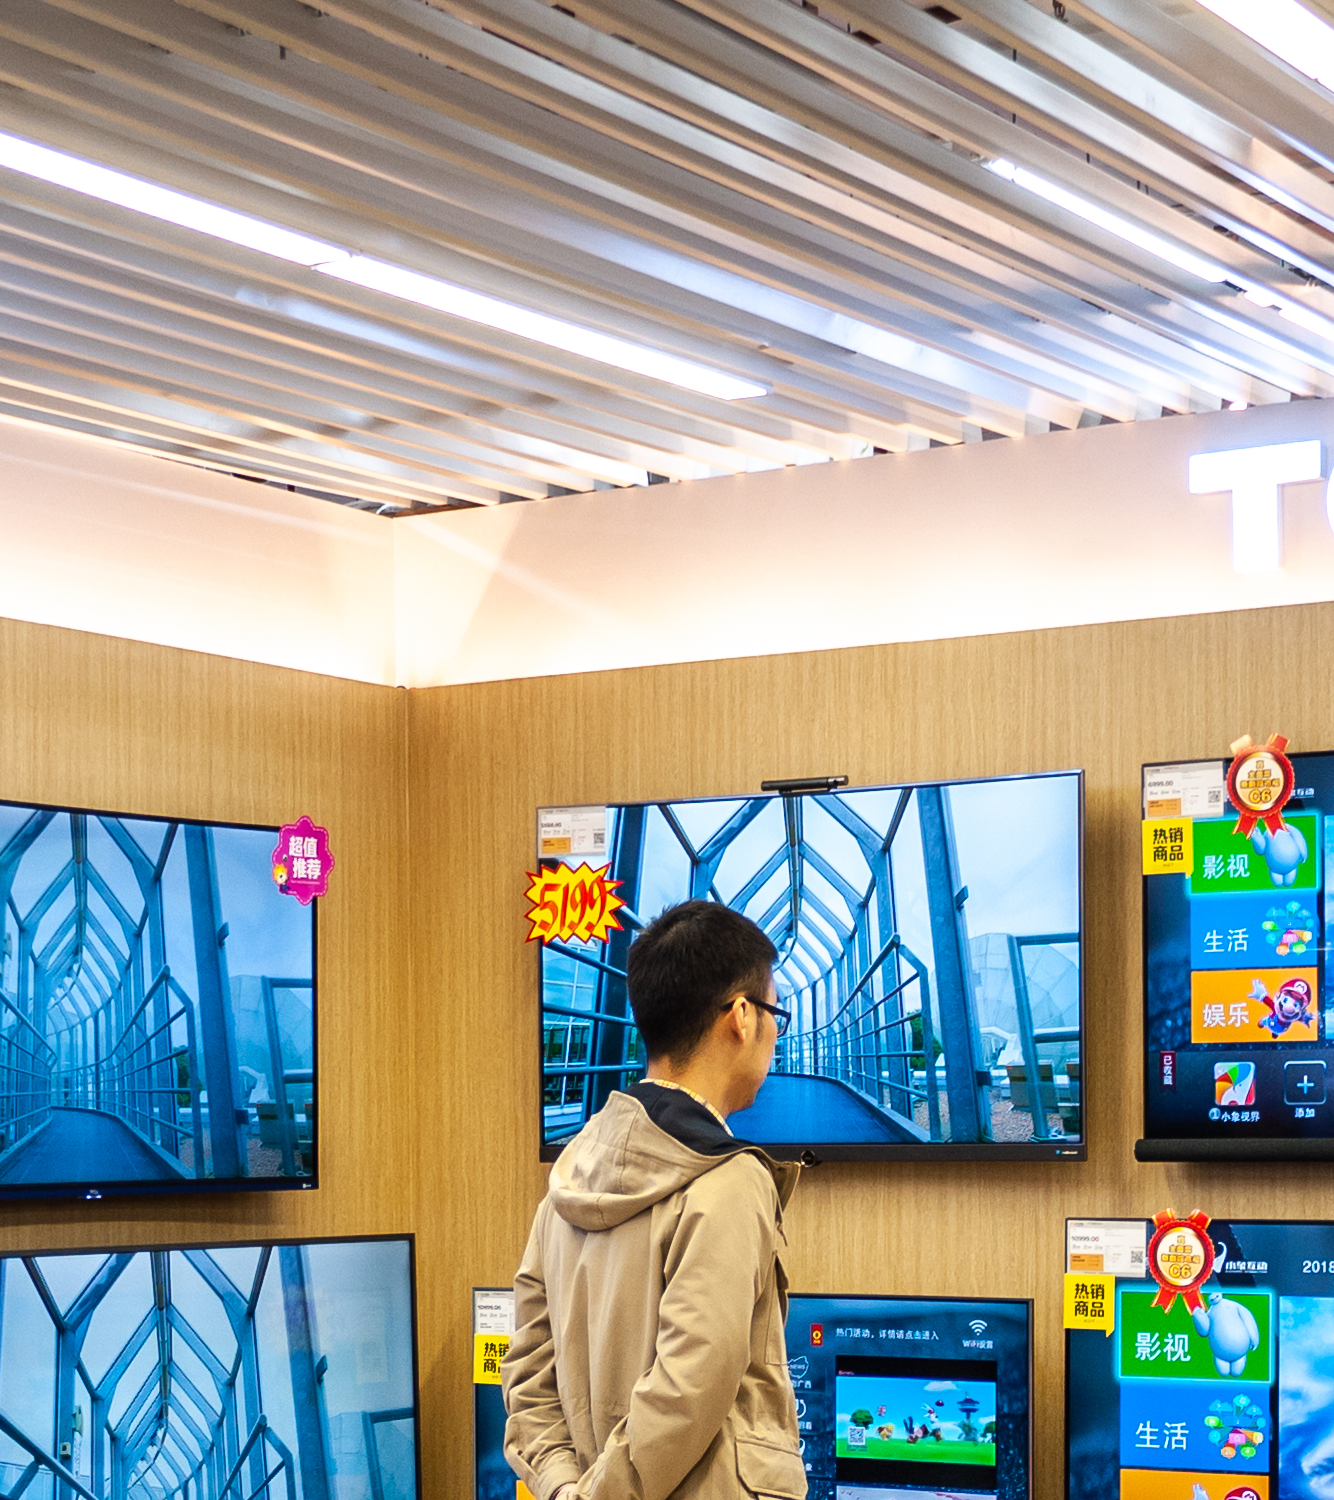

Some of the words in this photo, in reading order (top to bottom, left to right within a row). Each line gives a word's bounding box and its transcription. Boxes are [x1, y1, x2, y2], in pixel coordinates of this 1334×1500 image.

[1249, 789, 1271, 804] C6
[1153, 827, 1183, 844] 热销
[289, 836, 318, 858] 超值
[1153, 845, 1183, 862] 商品
[293, 858, 321, 879] 推荐
[1203, 854, 1250, 880] 影视
[538, 875, 607, 933] 5199
[1203, 927, 1248, 953] 生活
[1202, 1002, 1250, 1028] 娱乐
[1295, 1108, 1315, 1118] 添加
[1169, 1264, 1191, 1279] C6
[1074, 1283, 1105, 1300] 热销
[1074, 1301, 1104, 1318] 商品
[1135, 1332, 1191, 1362] 影视
[1135, 1421, 1189, 1450] 生活
